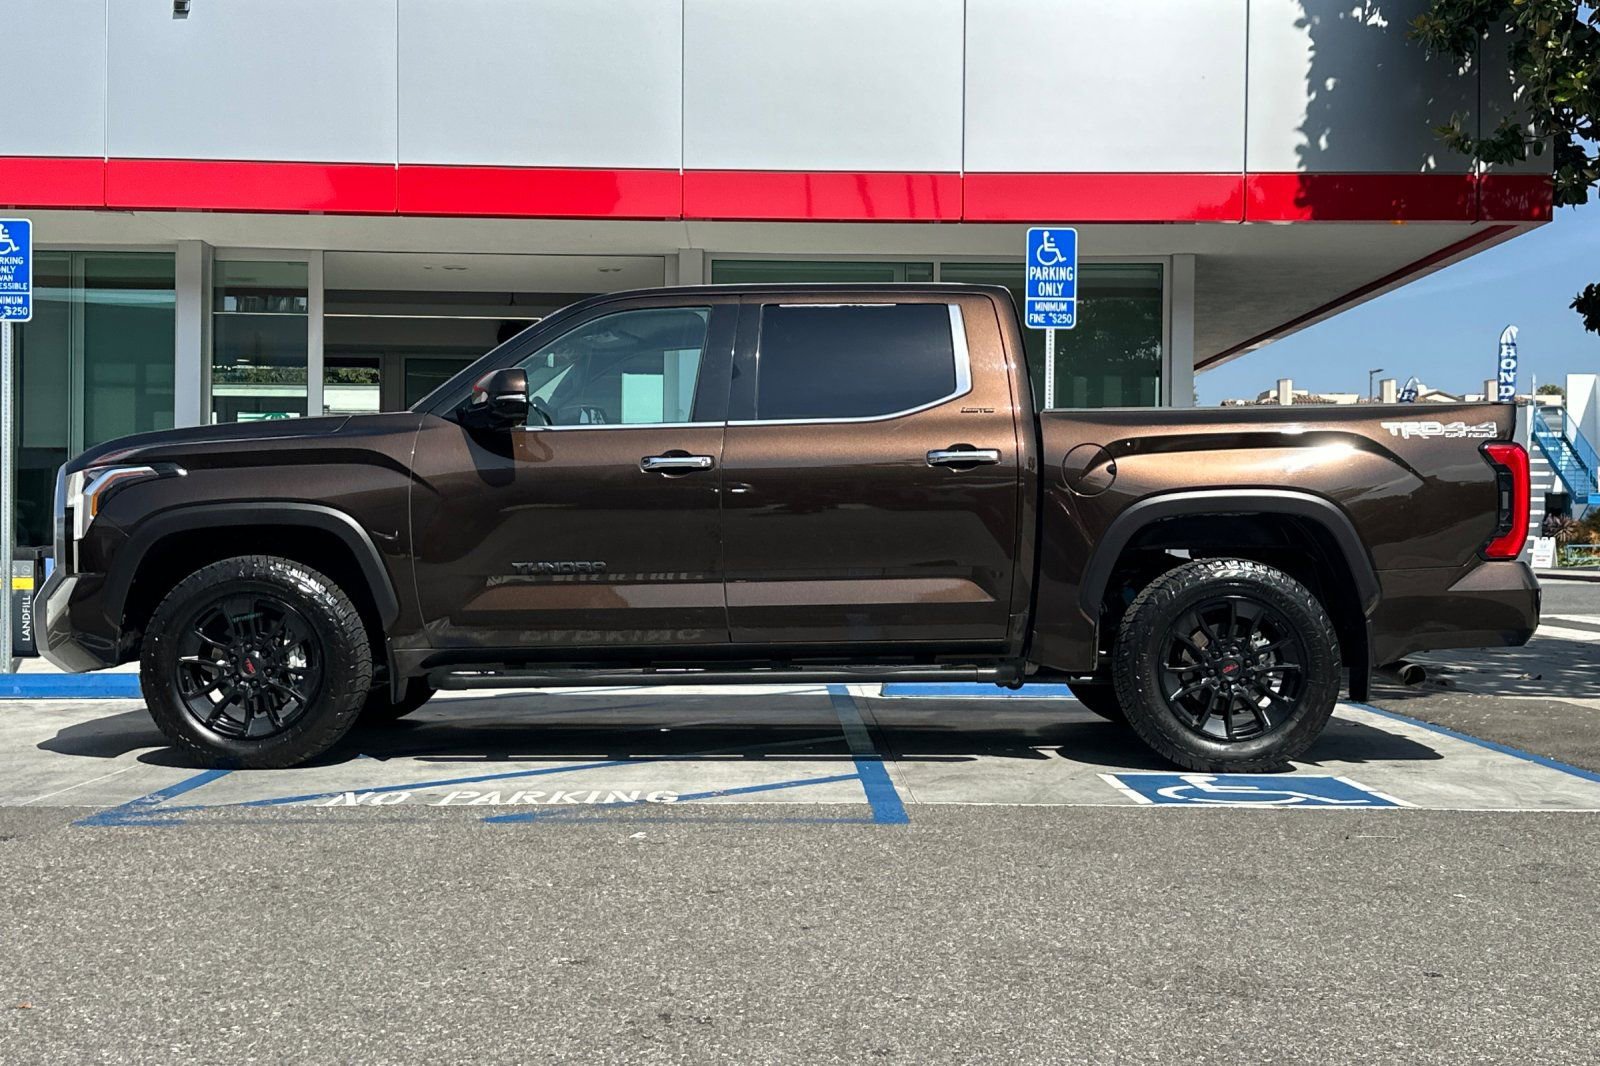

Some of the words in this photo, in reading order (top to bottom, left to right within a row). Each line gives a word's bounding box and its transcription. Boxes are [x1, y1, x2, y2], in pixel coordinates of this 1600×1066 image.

[0, 256, 24, 265] RKING
[0, 265, 16, 274] NLY
[1029, 266, 1073, 281] PARKING
[0, 282, 28, 290] ESSIBLE
[1038, 281, 1064, 296] ONLY
[0, 295, 24, 305] NIMUM
[1034, 302, 1067, 312] MINIMUM
[1029, 313, 1046, 324] FINE
[1051, 313, 1072, 324] $250
[1499, 344, 1516, 401] HOND
[1380, 421, 1445, 439] TRD
[22, 595, 31, 641] LANDFILL
[316, 791, 412, 806] NO
[430, 790, 679, 806] PARKING
